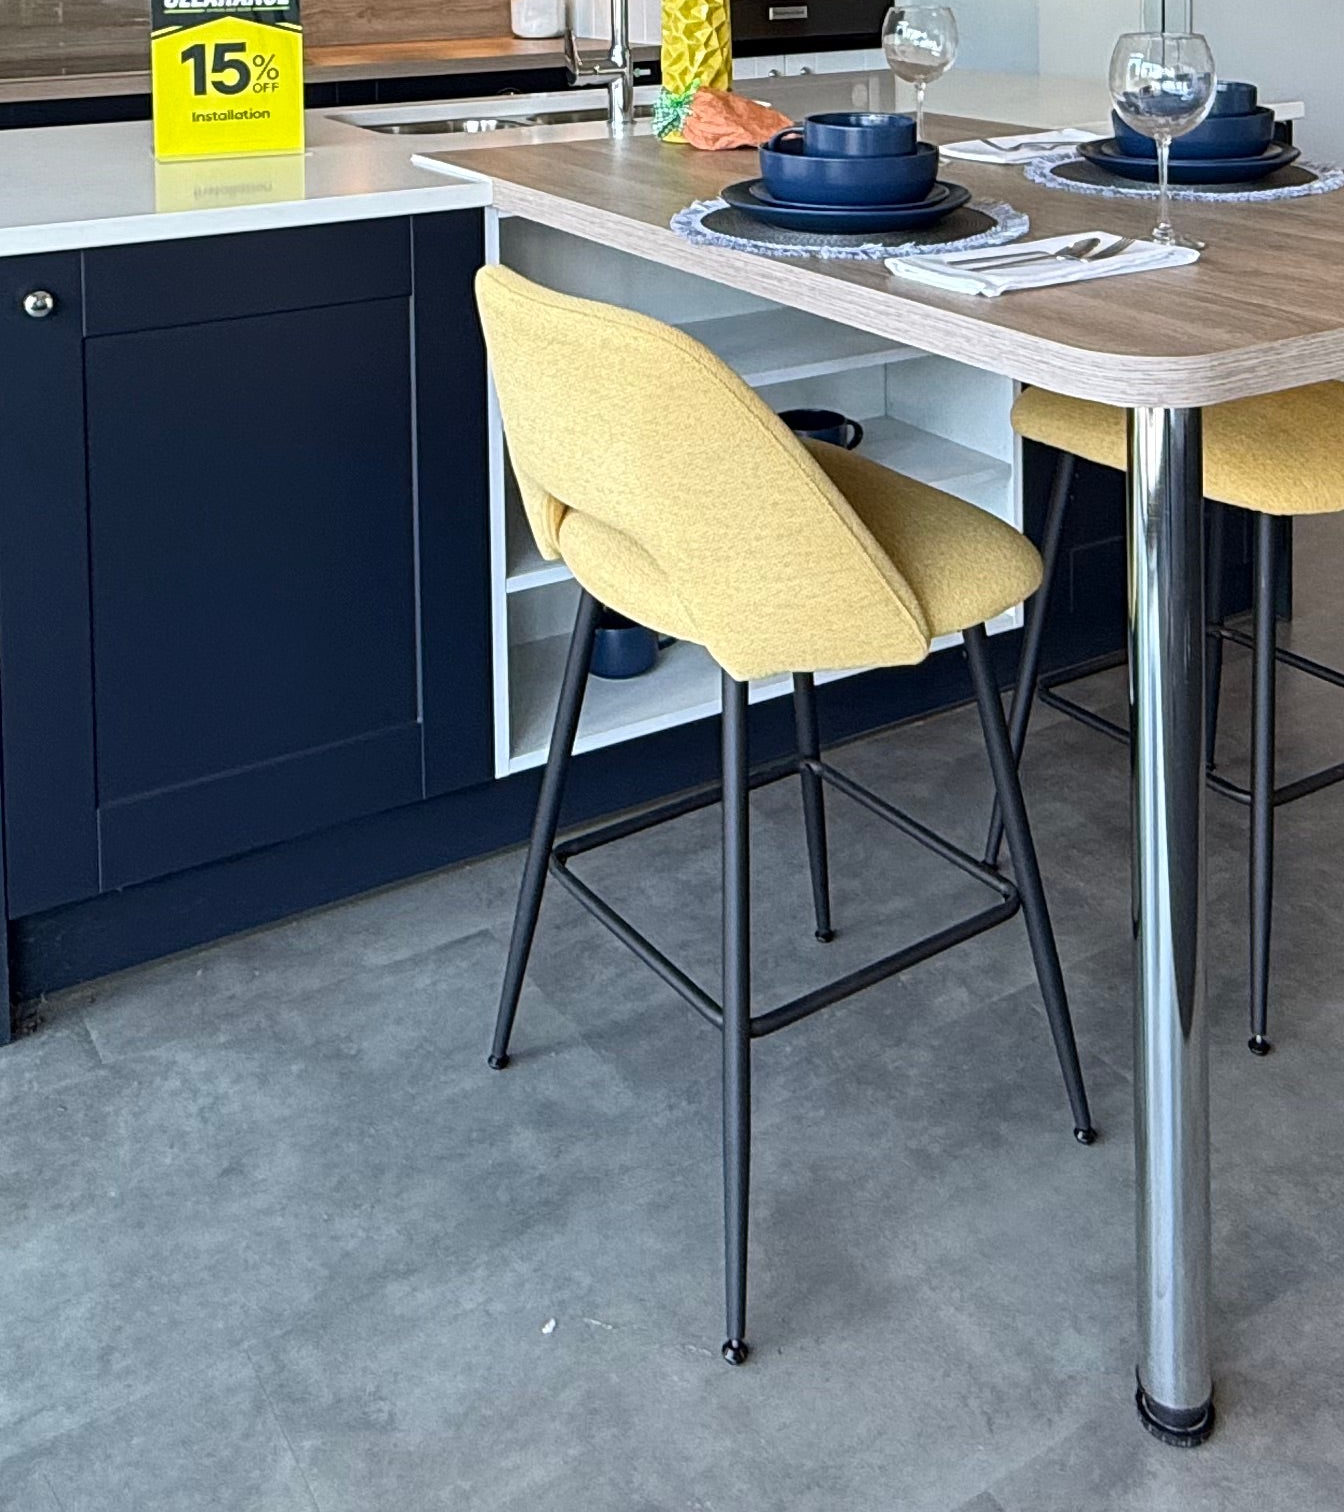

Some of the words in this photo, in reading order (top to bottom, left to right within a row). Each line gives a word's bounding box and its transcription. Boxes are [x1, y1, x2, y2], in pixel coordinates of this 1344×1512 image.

[181, 42, 280, 96] 15%
[253, 83, 279, 94] OFF
[192, 108, 270, 123] Installation
